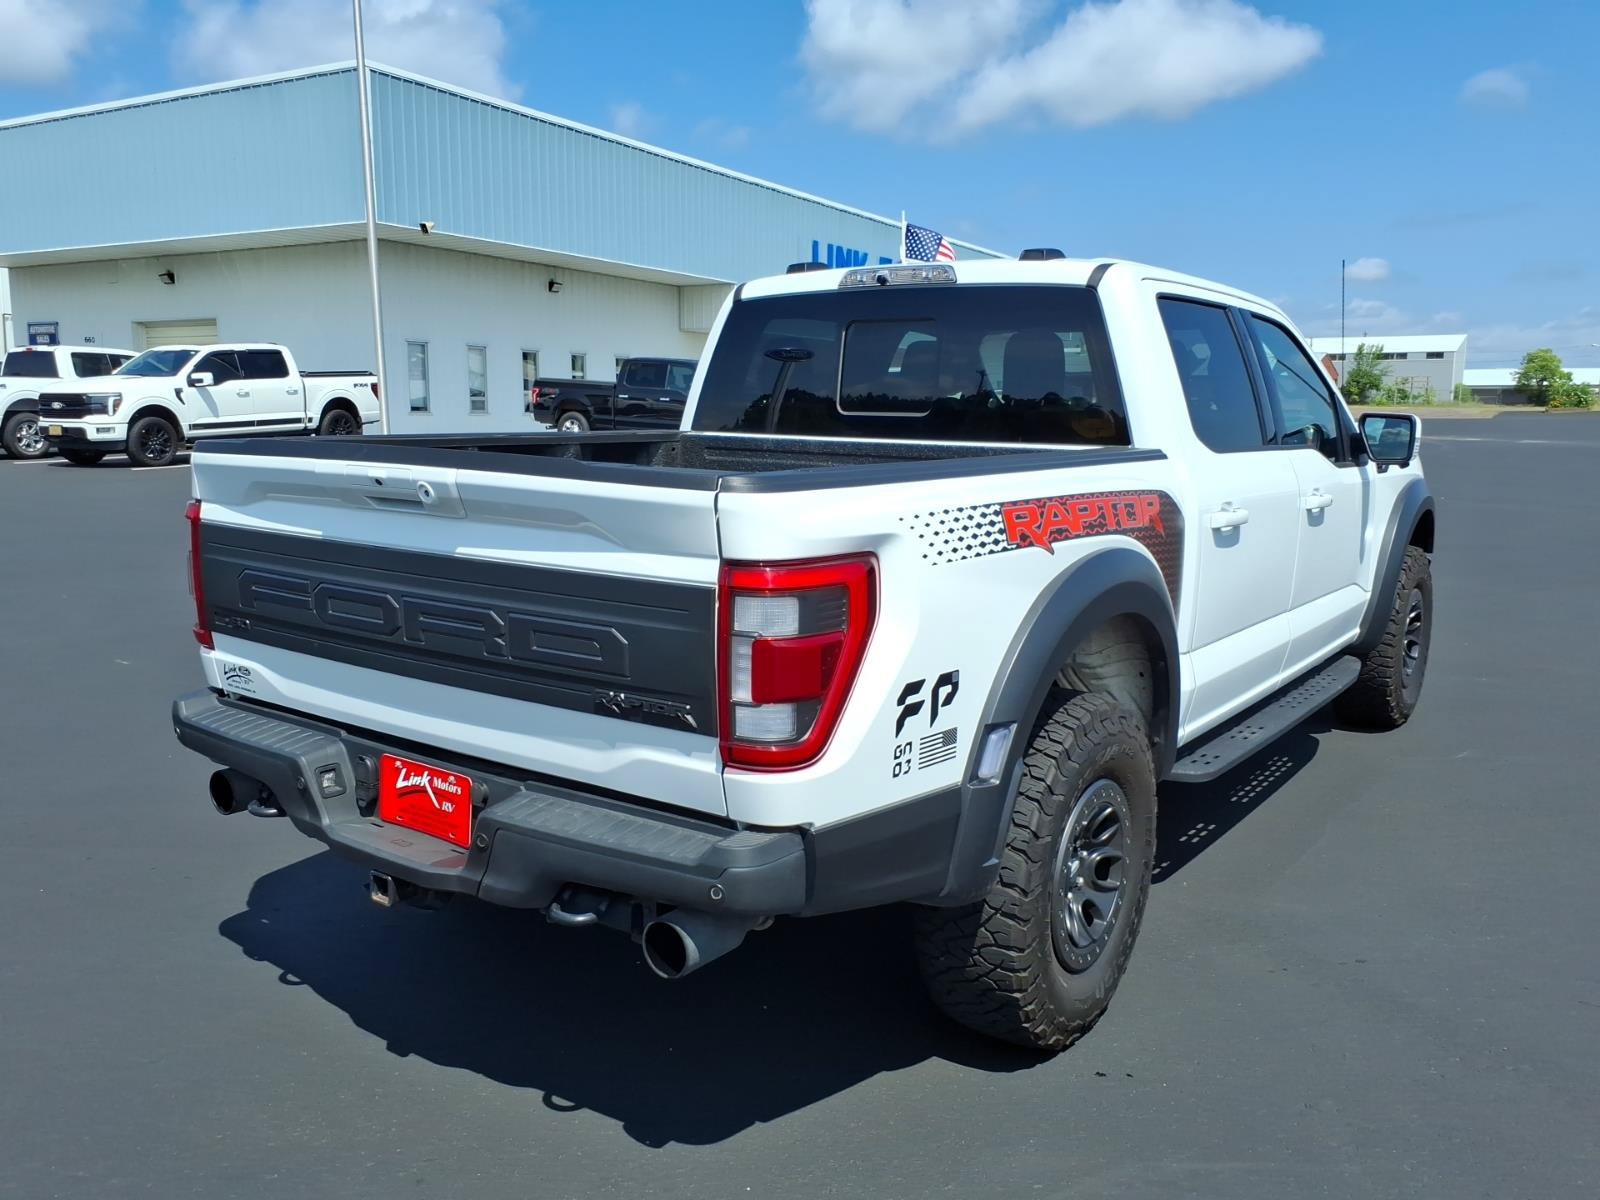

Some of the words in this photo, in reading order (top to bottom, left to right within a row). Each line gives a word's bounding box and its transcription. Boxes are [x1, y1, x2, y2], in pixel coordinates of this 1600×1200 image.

[1002, 495, 1165, 555] RAPTOR
[237, 568, 631, 679] FORD
[432, 775, 462, 795] Motors
[441, 800, 456, 813] RV
